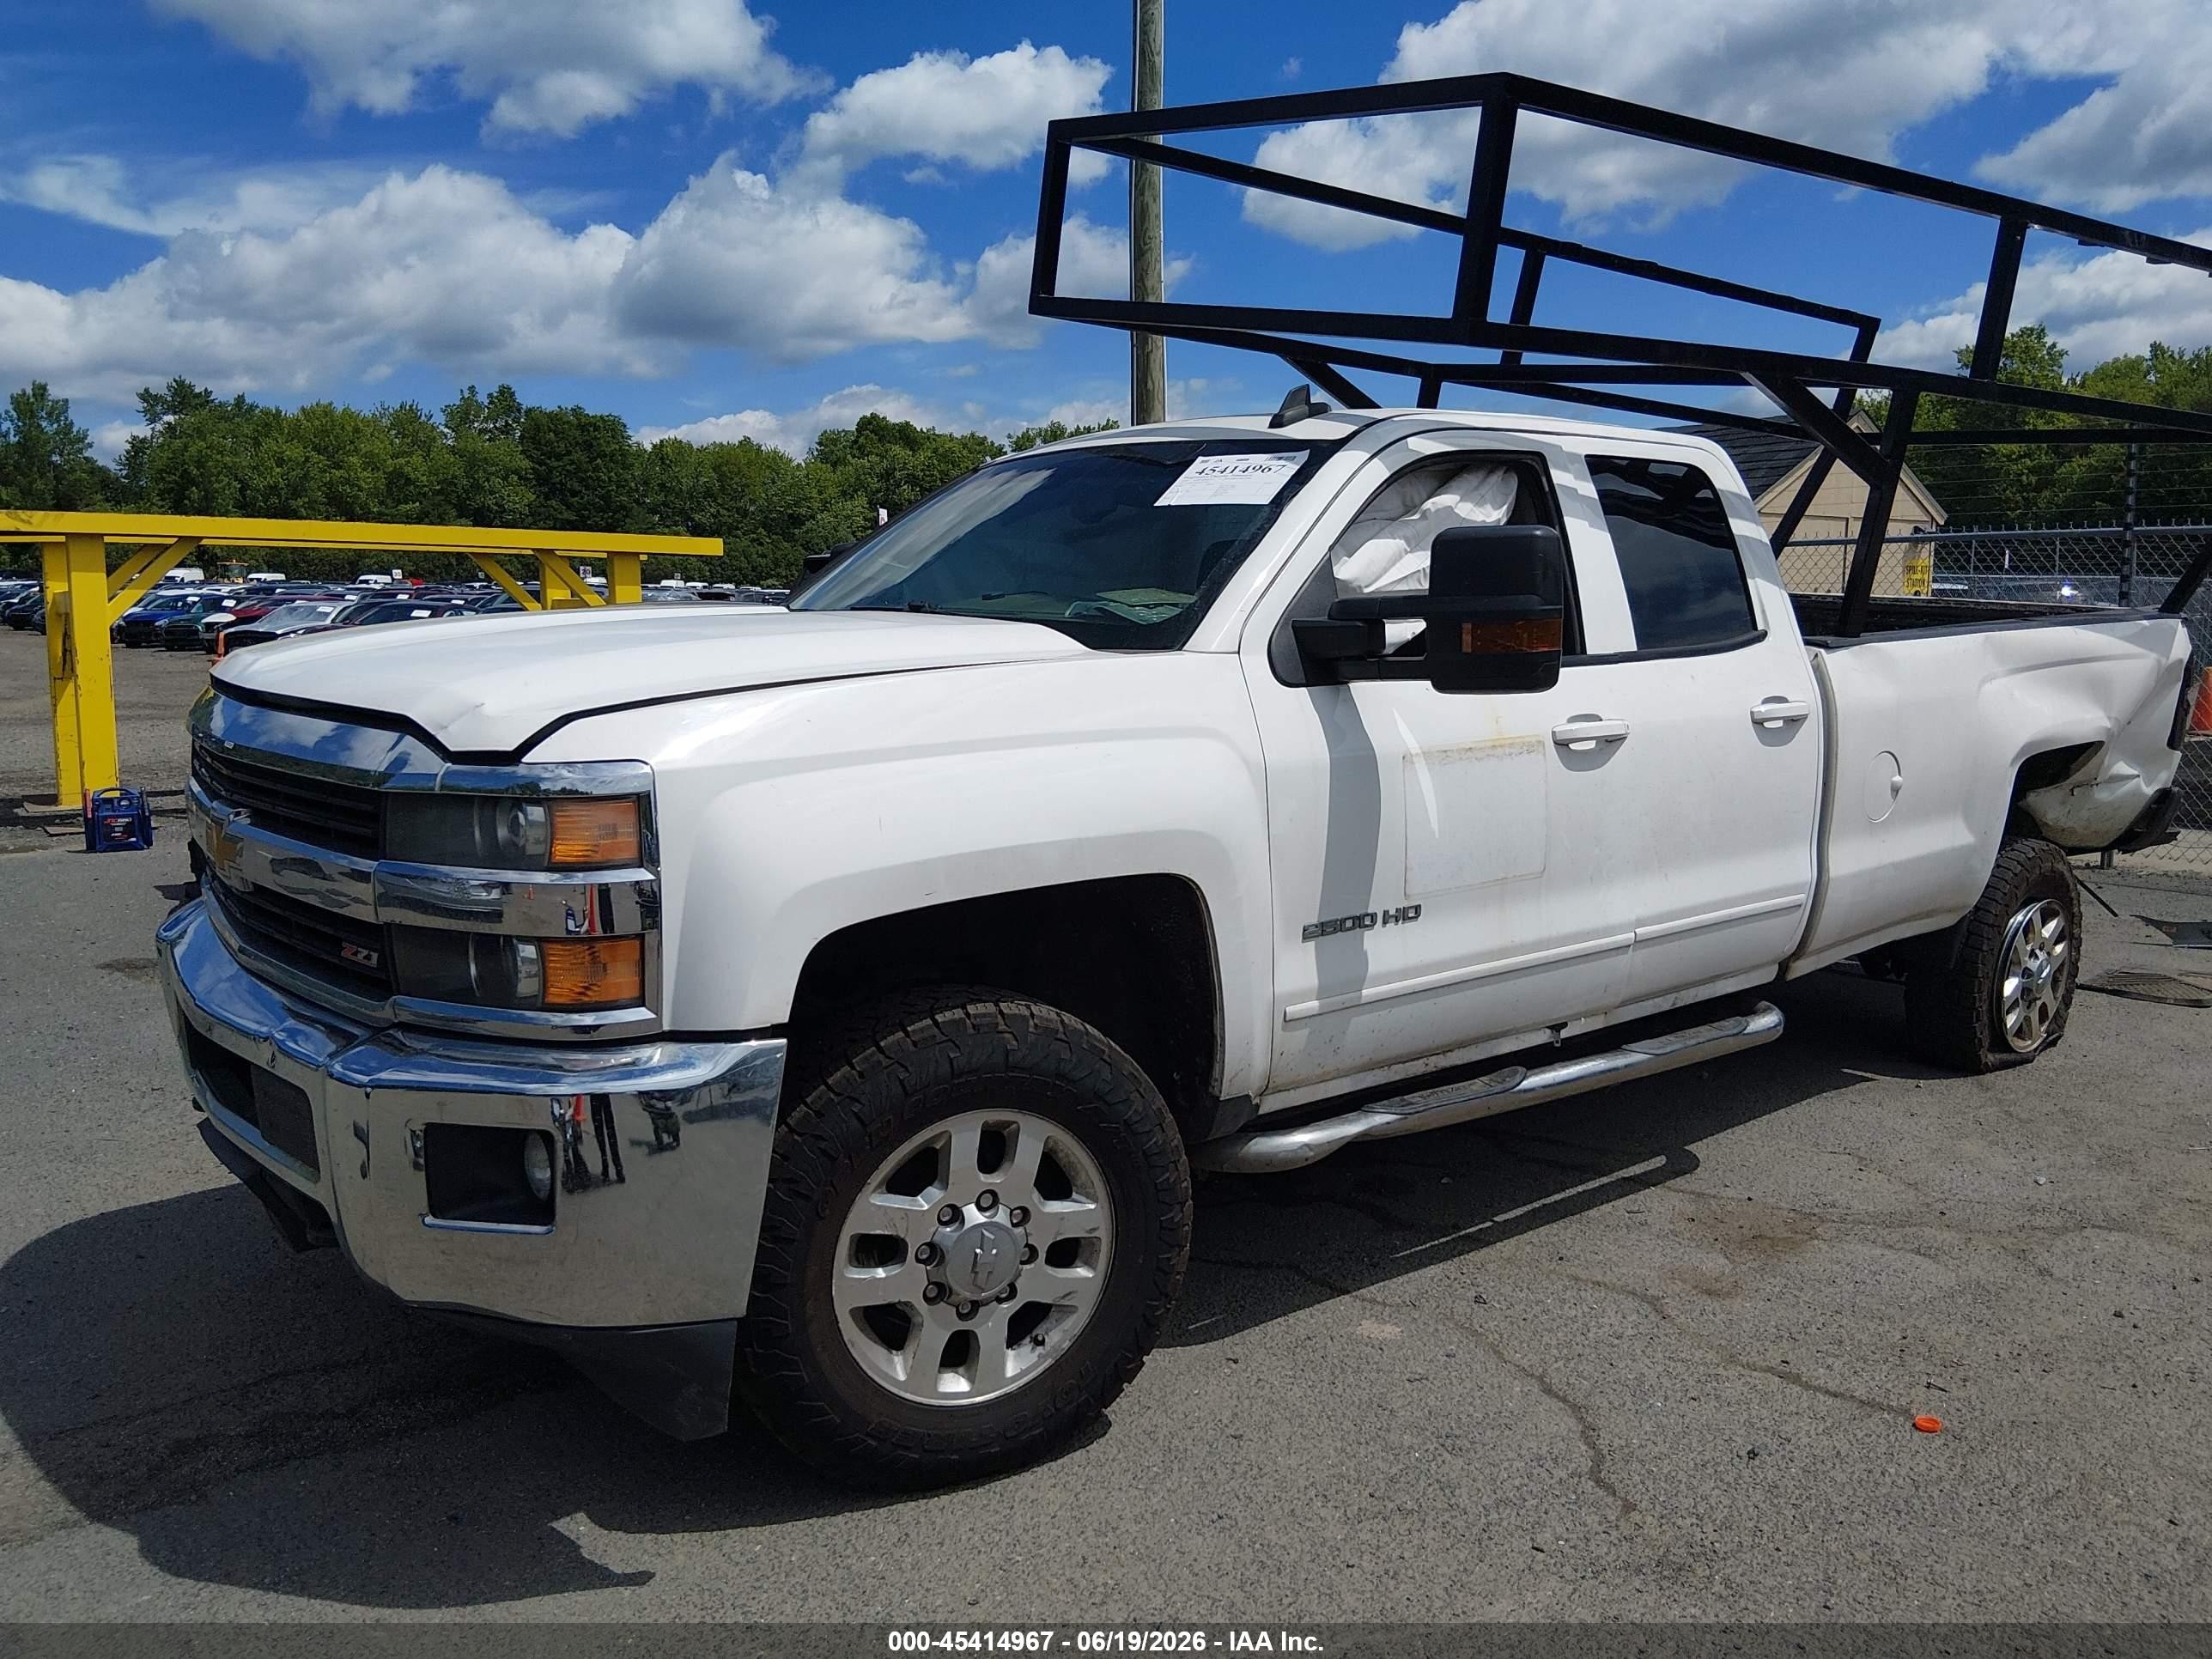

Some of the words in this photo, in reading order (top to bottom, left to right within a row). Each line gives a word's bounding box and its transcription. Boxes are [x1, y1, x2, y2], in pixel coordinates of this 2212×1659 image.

[1195, 465, 1286, 476] 45414967
[1906, 578, 1926, 588] STATION
[1302, 911, 1378, 943] 2500
[1382, 904, 1422, 927] HD
[341, 941, 379, 968] Z71
